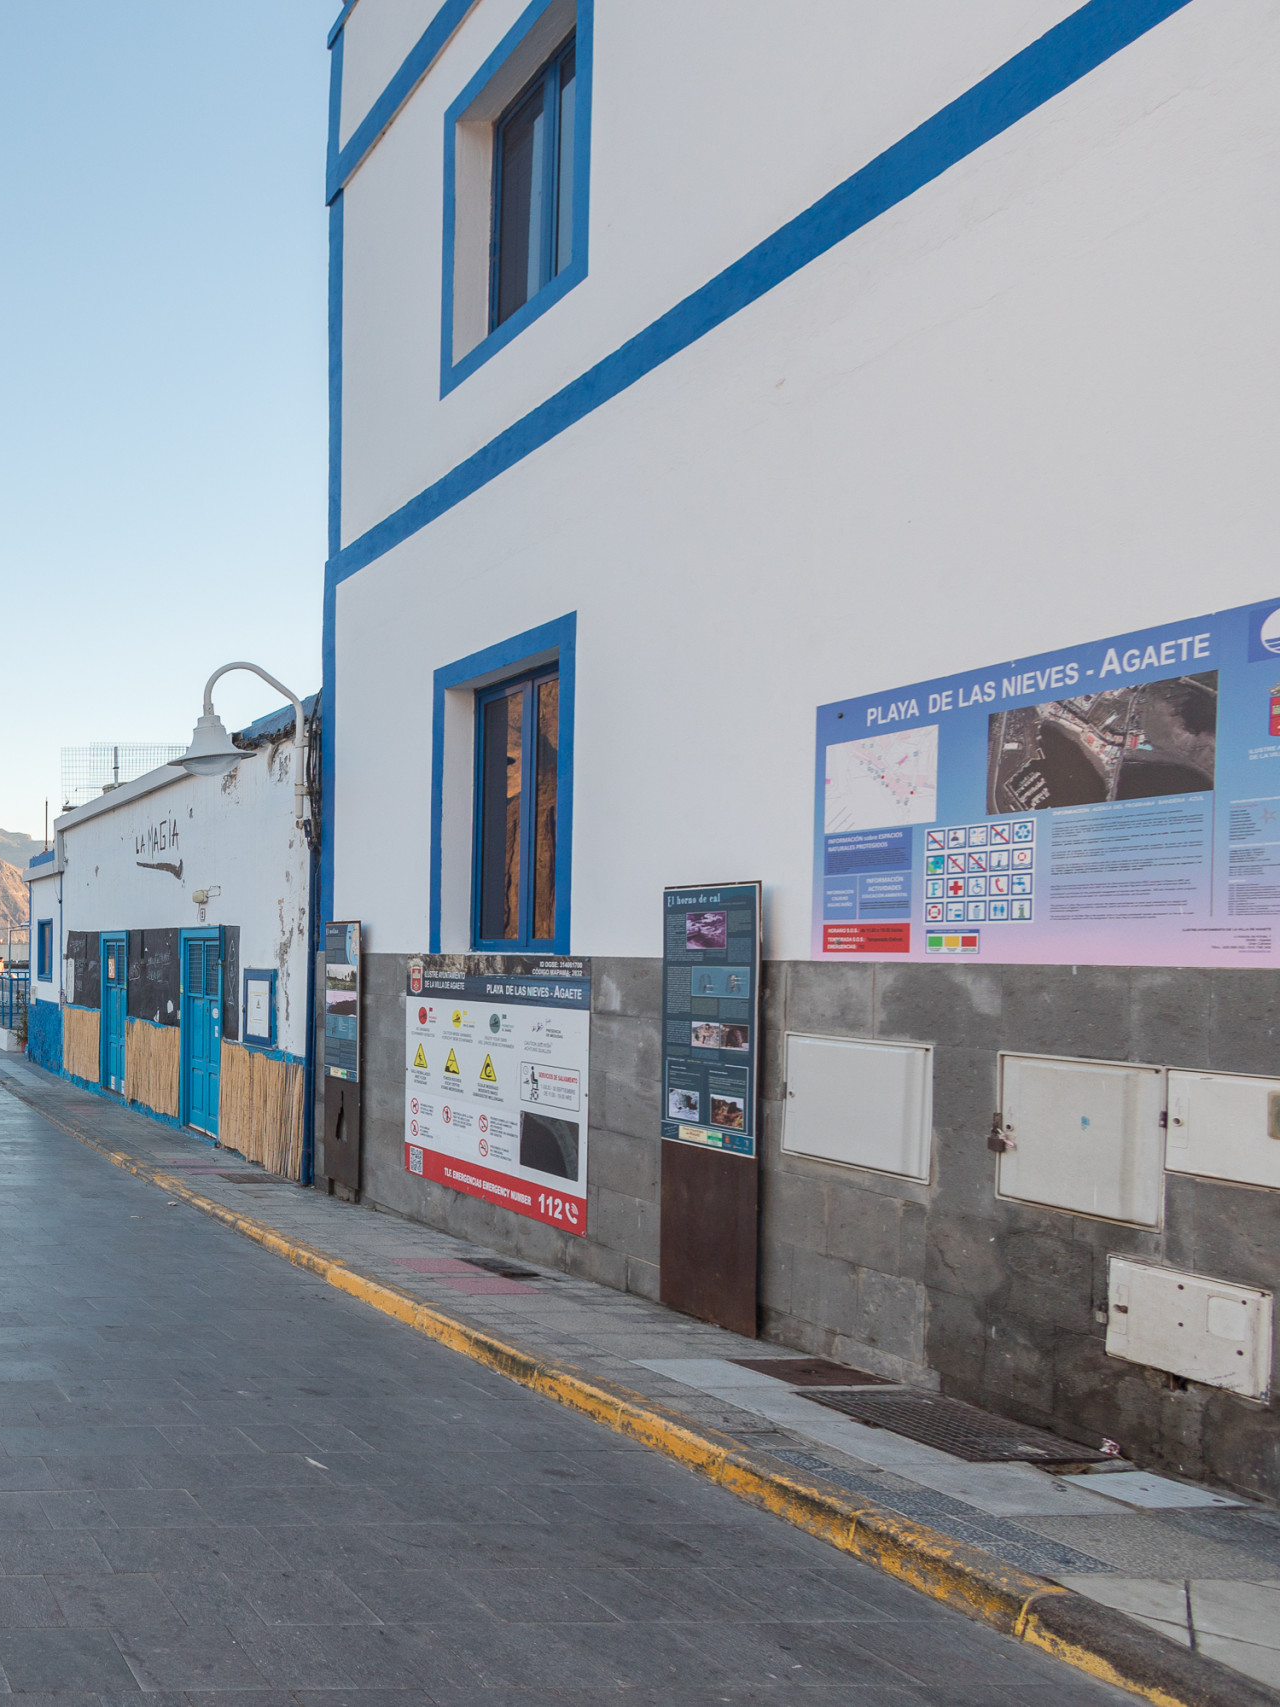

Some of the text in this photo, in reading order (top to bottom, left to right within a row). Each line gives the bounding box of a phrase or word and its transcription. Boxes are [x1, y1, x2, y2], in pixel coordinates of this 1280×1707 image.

[866, 699, 920, 727] PLAYA
[928, 689, 953, 714] DE
[958, 680, 996, 708] LAS
[1001, 662, 1079, 697] NIEVES
[1099, 633, 1211, 679] AGAETE
[136, 834, 145, 854] LA
[667, 893, 720, 907] El horno de cal
[486, 984, 504, 995] PLAYA
[505, 985, 514, 996] DE
[515, 985, 526, 996] LAS
[527, 986, 549, 998] NIEVES
[452, 1169, 483, 1189] EMERGENCIAS
[482, 1180, 511, 1199] EMERGENCY
[510, 1190, 532, 1206] NUMBER
[539, 1193, 563, 1220] 112
